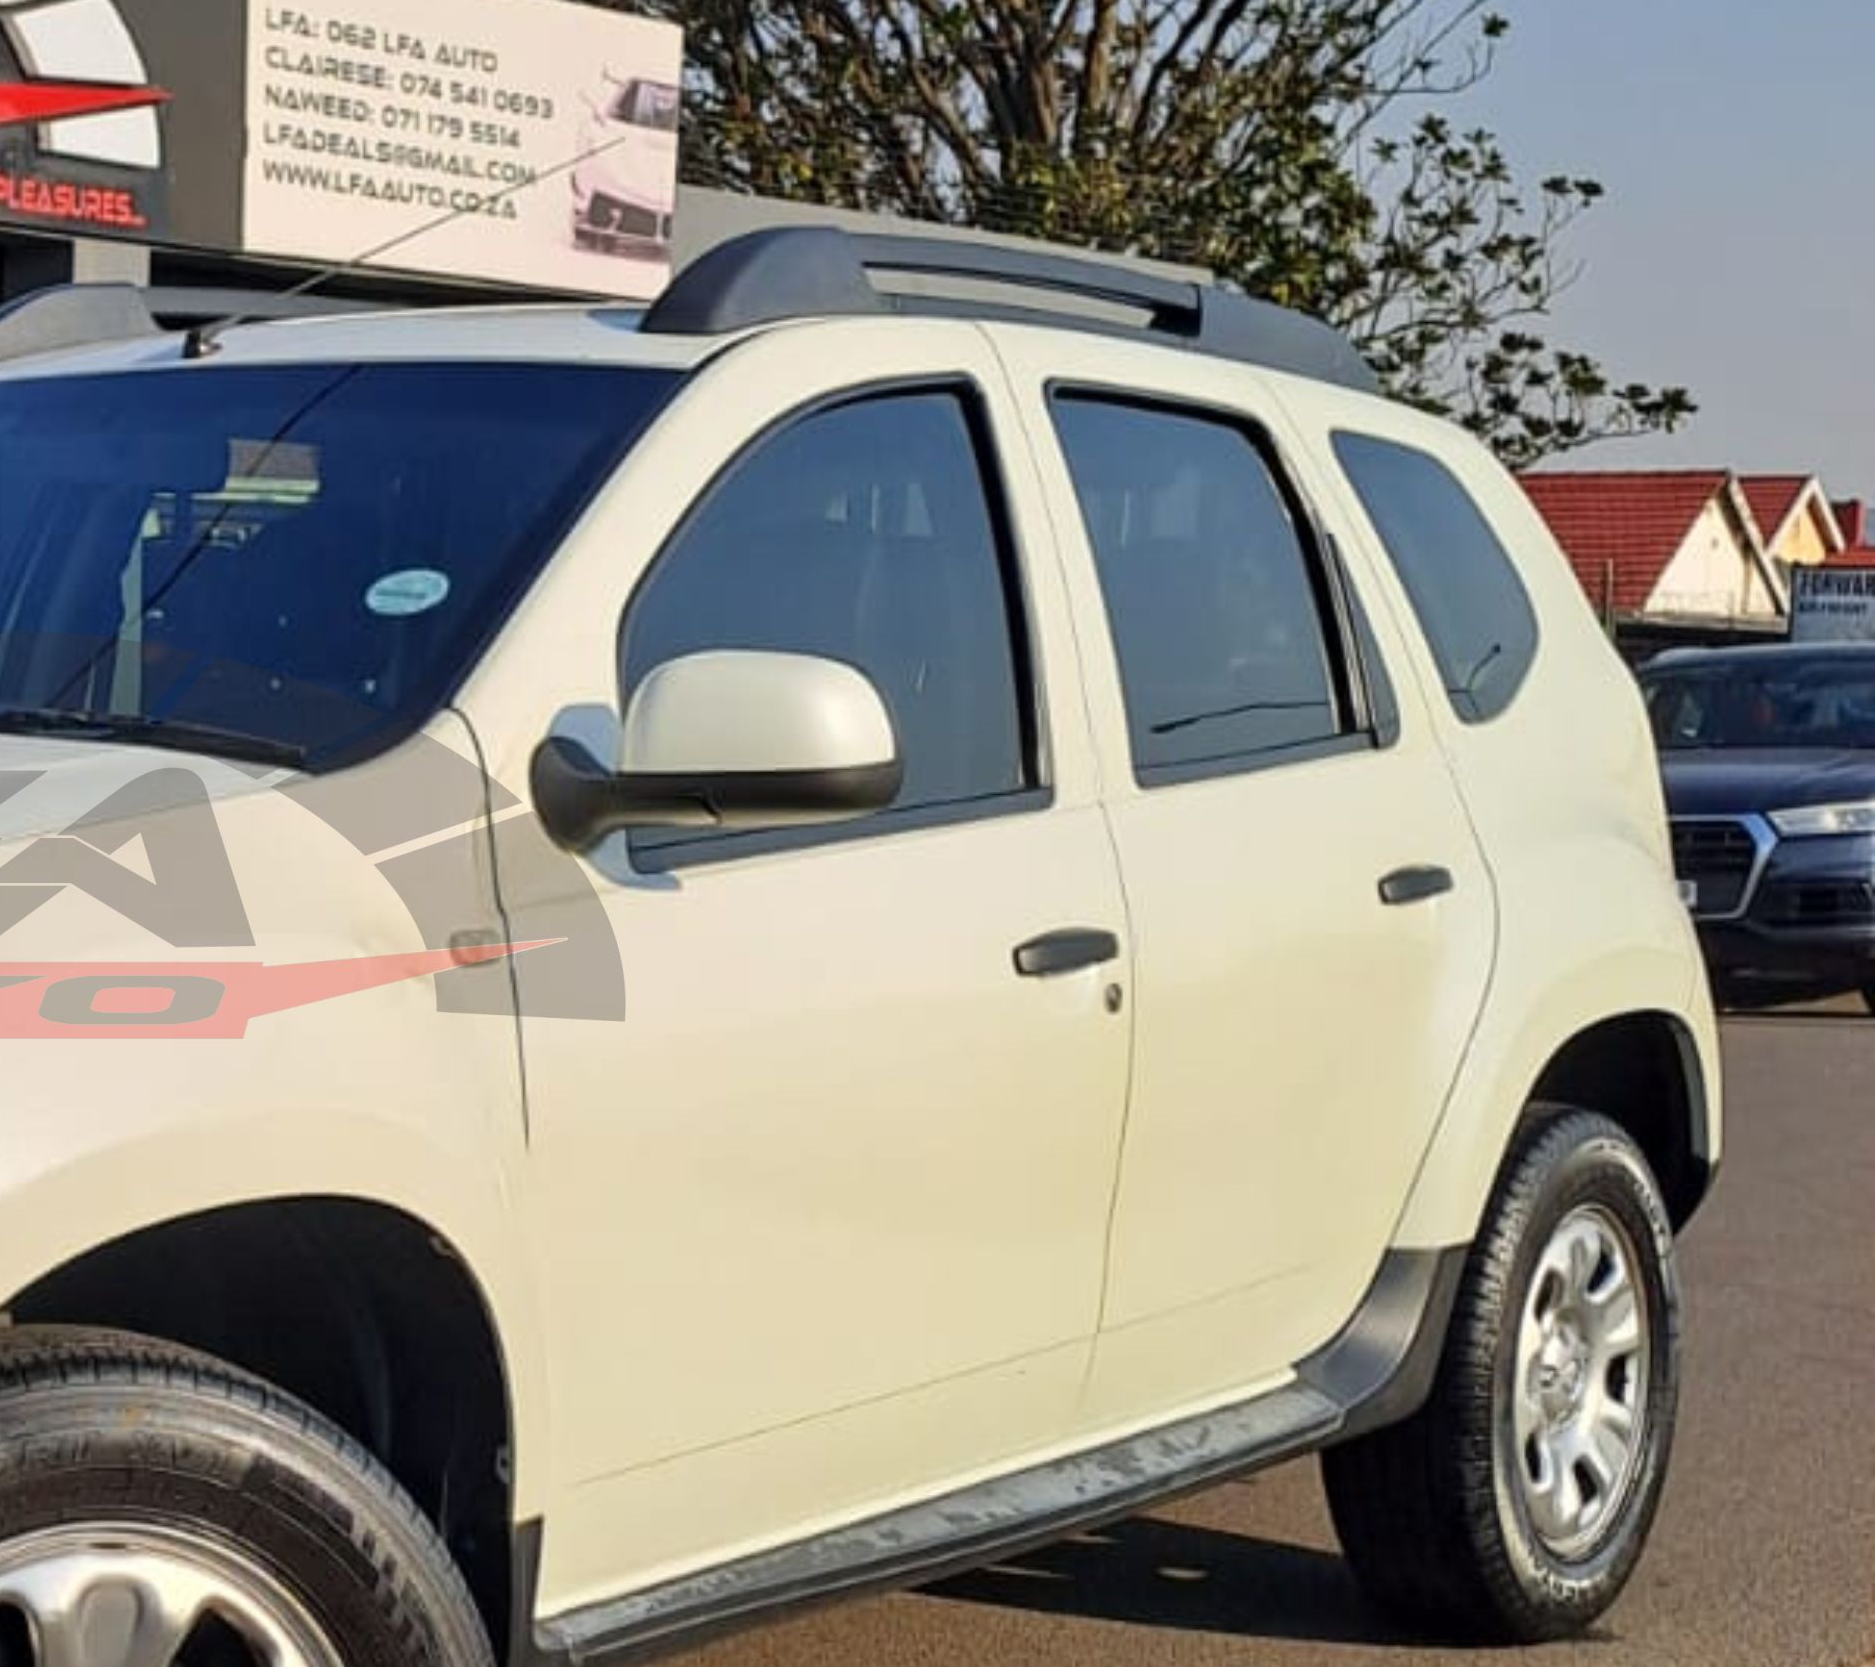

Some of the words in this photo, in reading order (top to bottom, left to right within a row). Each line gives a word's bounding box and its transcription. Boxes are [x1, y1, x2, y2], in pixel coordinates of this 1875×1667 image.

[264, 7, 320, 38] LFA:
[326, 20, 376, 50] 062
[383, 32, 426, 60] LFA
[434, 42, 499, 73] AUTO
[264, 45, 394, 89] CLAIRESE:
[399, 72, 443, 99] 074
[449, 82, 488, 109] 541
[493, 89, 554, 119] 0693
[263, 84, 375, 125] NAWEED:
[381, 104, 420, 131] 071
[427, 115, 464, 138] 179
[469, 120, 521, 149] 5514
[262, 158, 518, 219] WWW.LFAAUTO.CO.ZA
